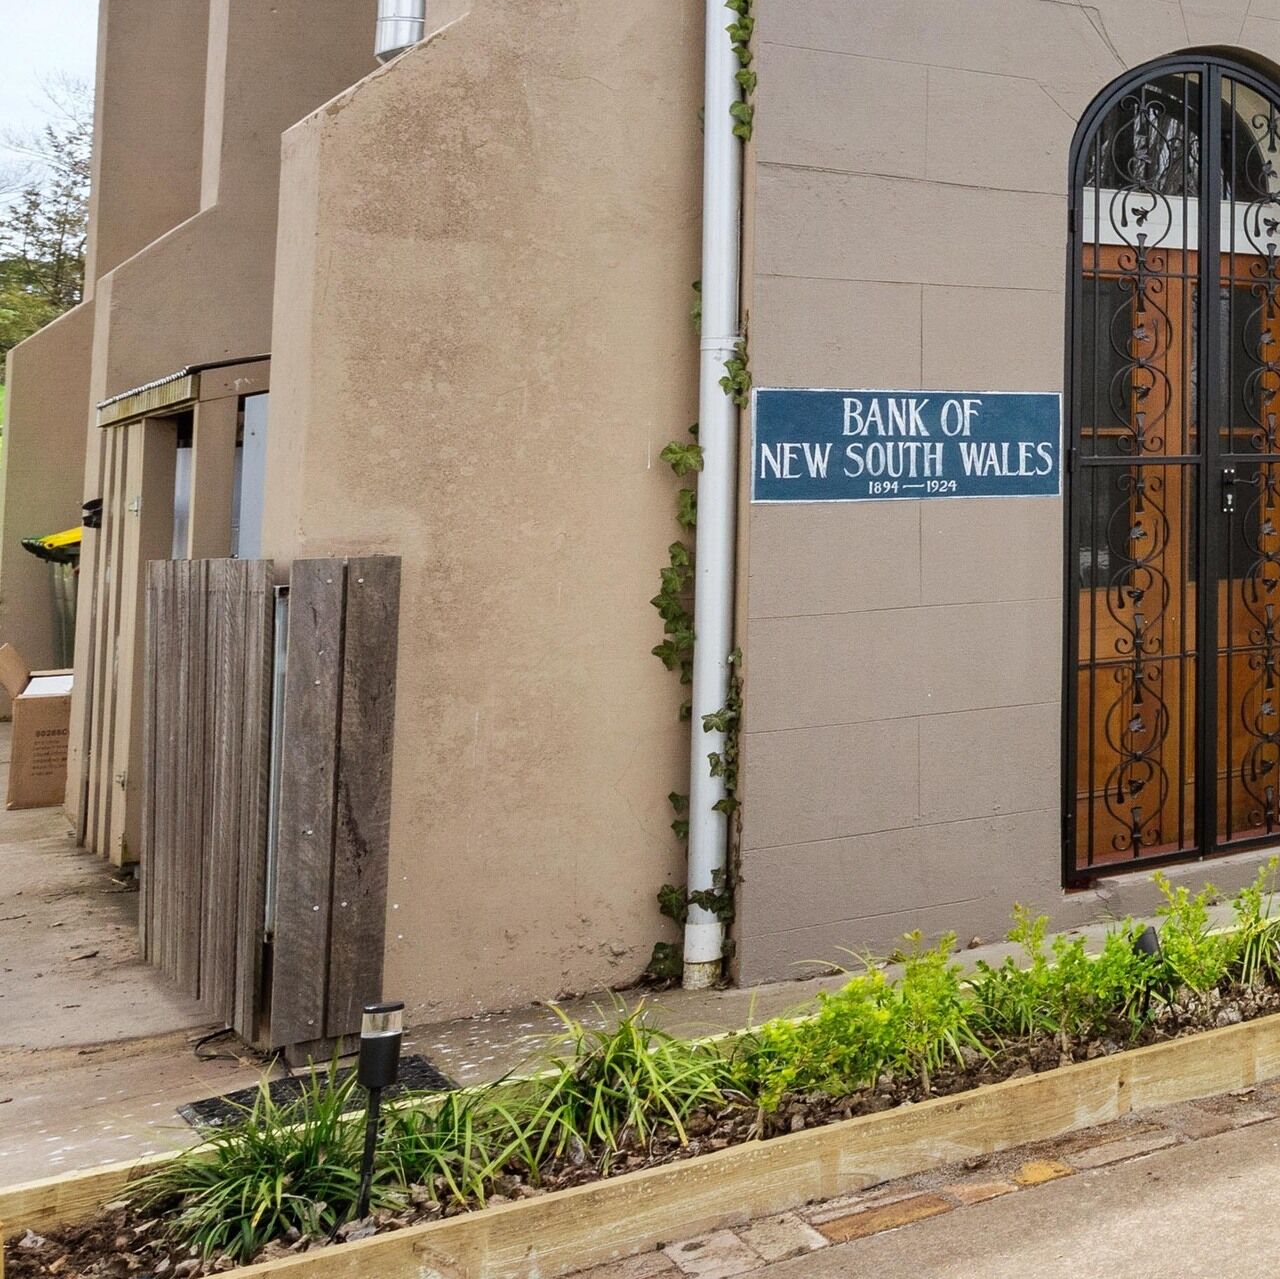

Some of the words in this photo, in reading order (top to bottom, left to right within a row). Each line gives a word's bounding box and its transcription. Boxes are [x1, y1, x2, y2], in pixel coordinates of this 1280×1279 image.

[842, 398, 930, 436] BANK
[941, 399, 983, 436] OF
[760, 442, 833, 479] NEW
[844, 442, 944, 478] SOUTH
[959, 442, 1053, 477] WALES
